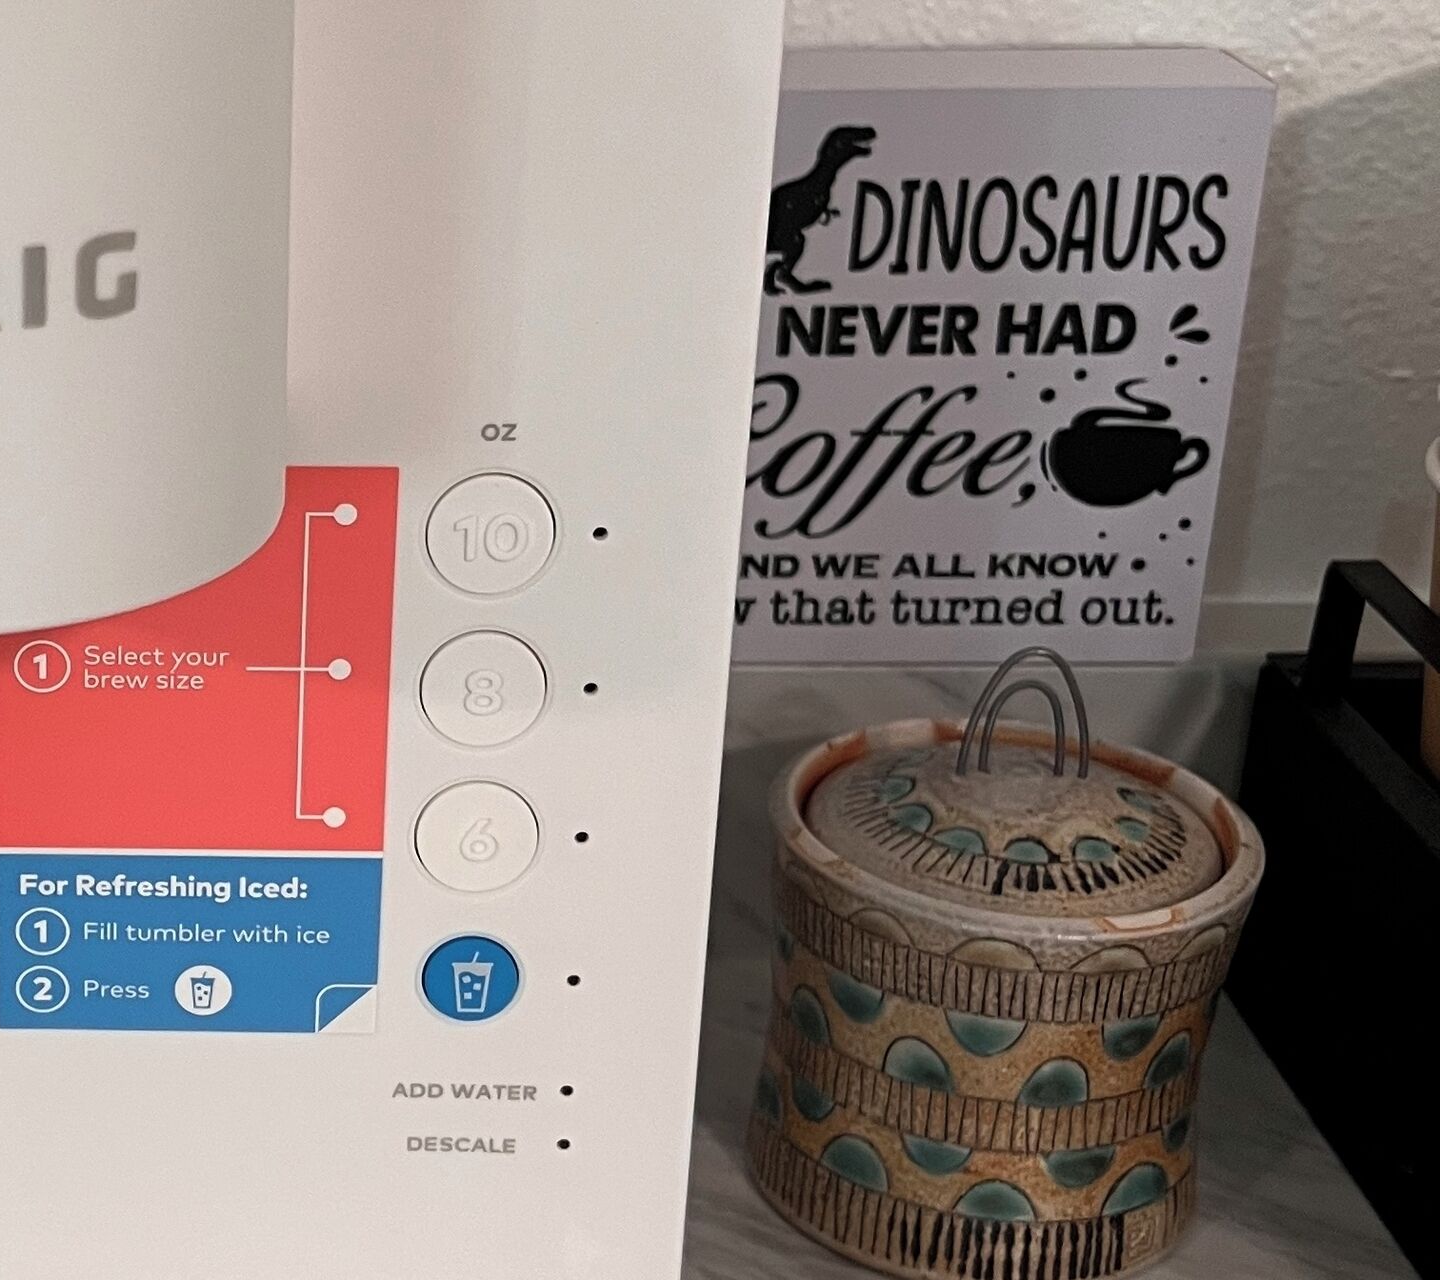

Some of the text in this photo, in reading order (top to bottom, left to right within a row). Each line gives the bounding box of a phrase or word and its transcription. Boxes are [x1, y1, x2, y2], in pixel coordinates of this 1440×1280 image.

[847, 173, 1229, 275] DINOSAURS
[774, 303, 1137, 358] NEVER HAD
[480, 422, 518, 442] OZ
[453, 512, 530, 563] 10
[740, 552, 1120, 579] ND WE ALL KNOW
[770, 588, 878, 626] that
[891, 589, 1064, 627] turned
[1080, 589, 1175, 627] out.
[31, 644, 231, 680] 1 Select your
[83, 667, 205, 690] brew size
[463, 669, 505, 717] 8
[459, 817, 500, 863] 6
[19, 872, 308, 904] For Refreshing Iced:
[33, 919, 331, 945] 1 Fill tumbler with ice
[32, 976, 151, 1002] 2 Press
[391, 1082, 538, 1102] ADD WATER
[405, 1136, 517, 1154] DESCALE
